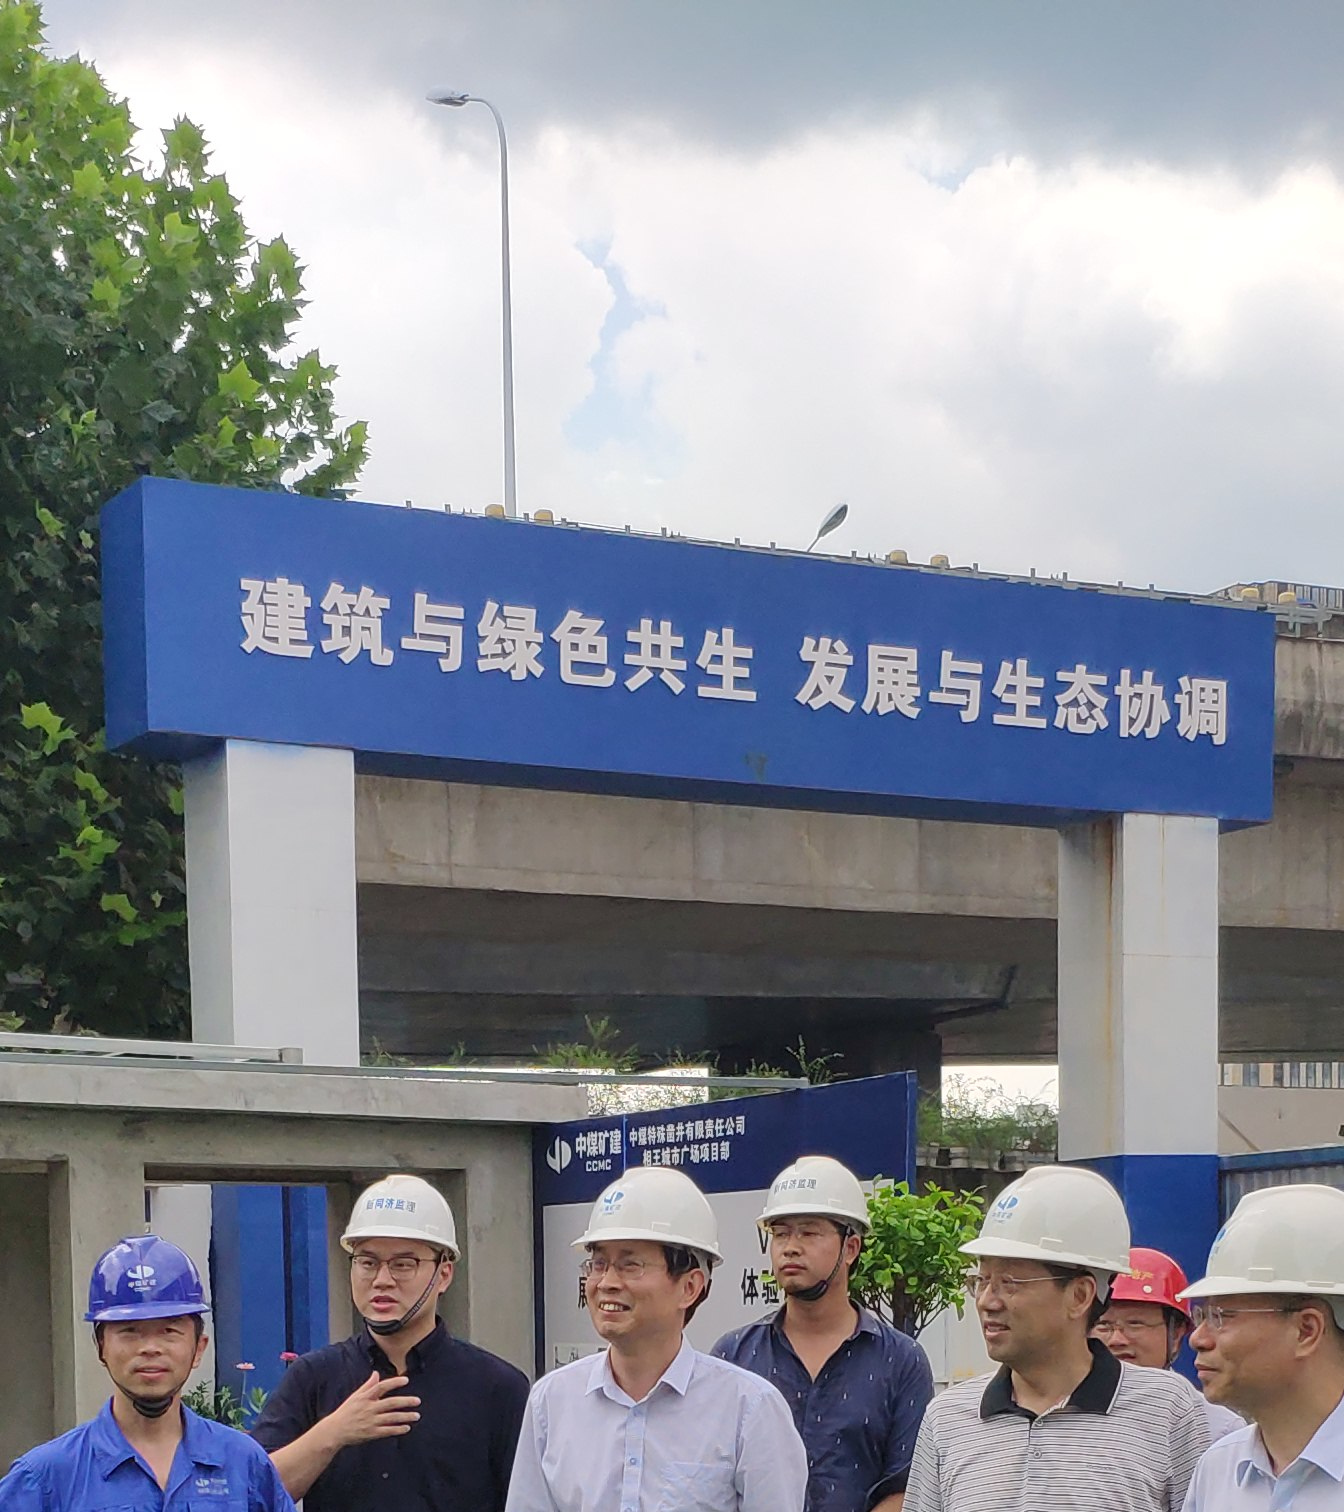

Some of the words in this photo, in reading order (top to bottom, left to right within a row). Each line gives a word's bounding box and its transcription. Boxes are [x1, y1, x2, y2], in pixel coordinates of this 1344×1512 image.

[239, 576, 759, 705] 建筑与绿色共生
[794, 634, 1230, 748] 发展与生态协调
[575, 1128, 622, 1159] 中煤矿建
[629, 1115, 746, 1148] 中煤特殊凿井有限责任公司
[585, 1158, 612, 1172] CCMC
[642, 1140, 731, 1168] 相王城市广场项目部
